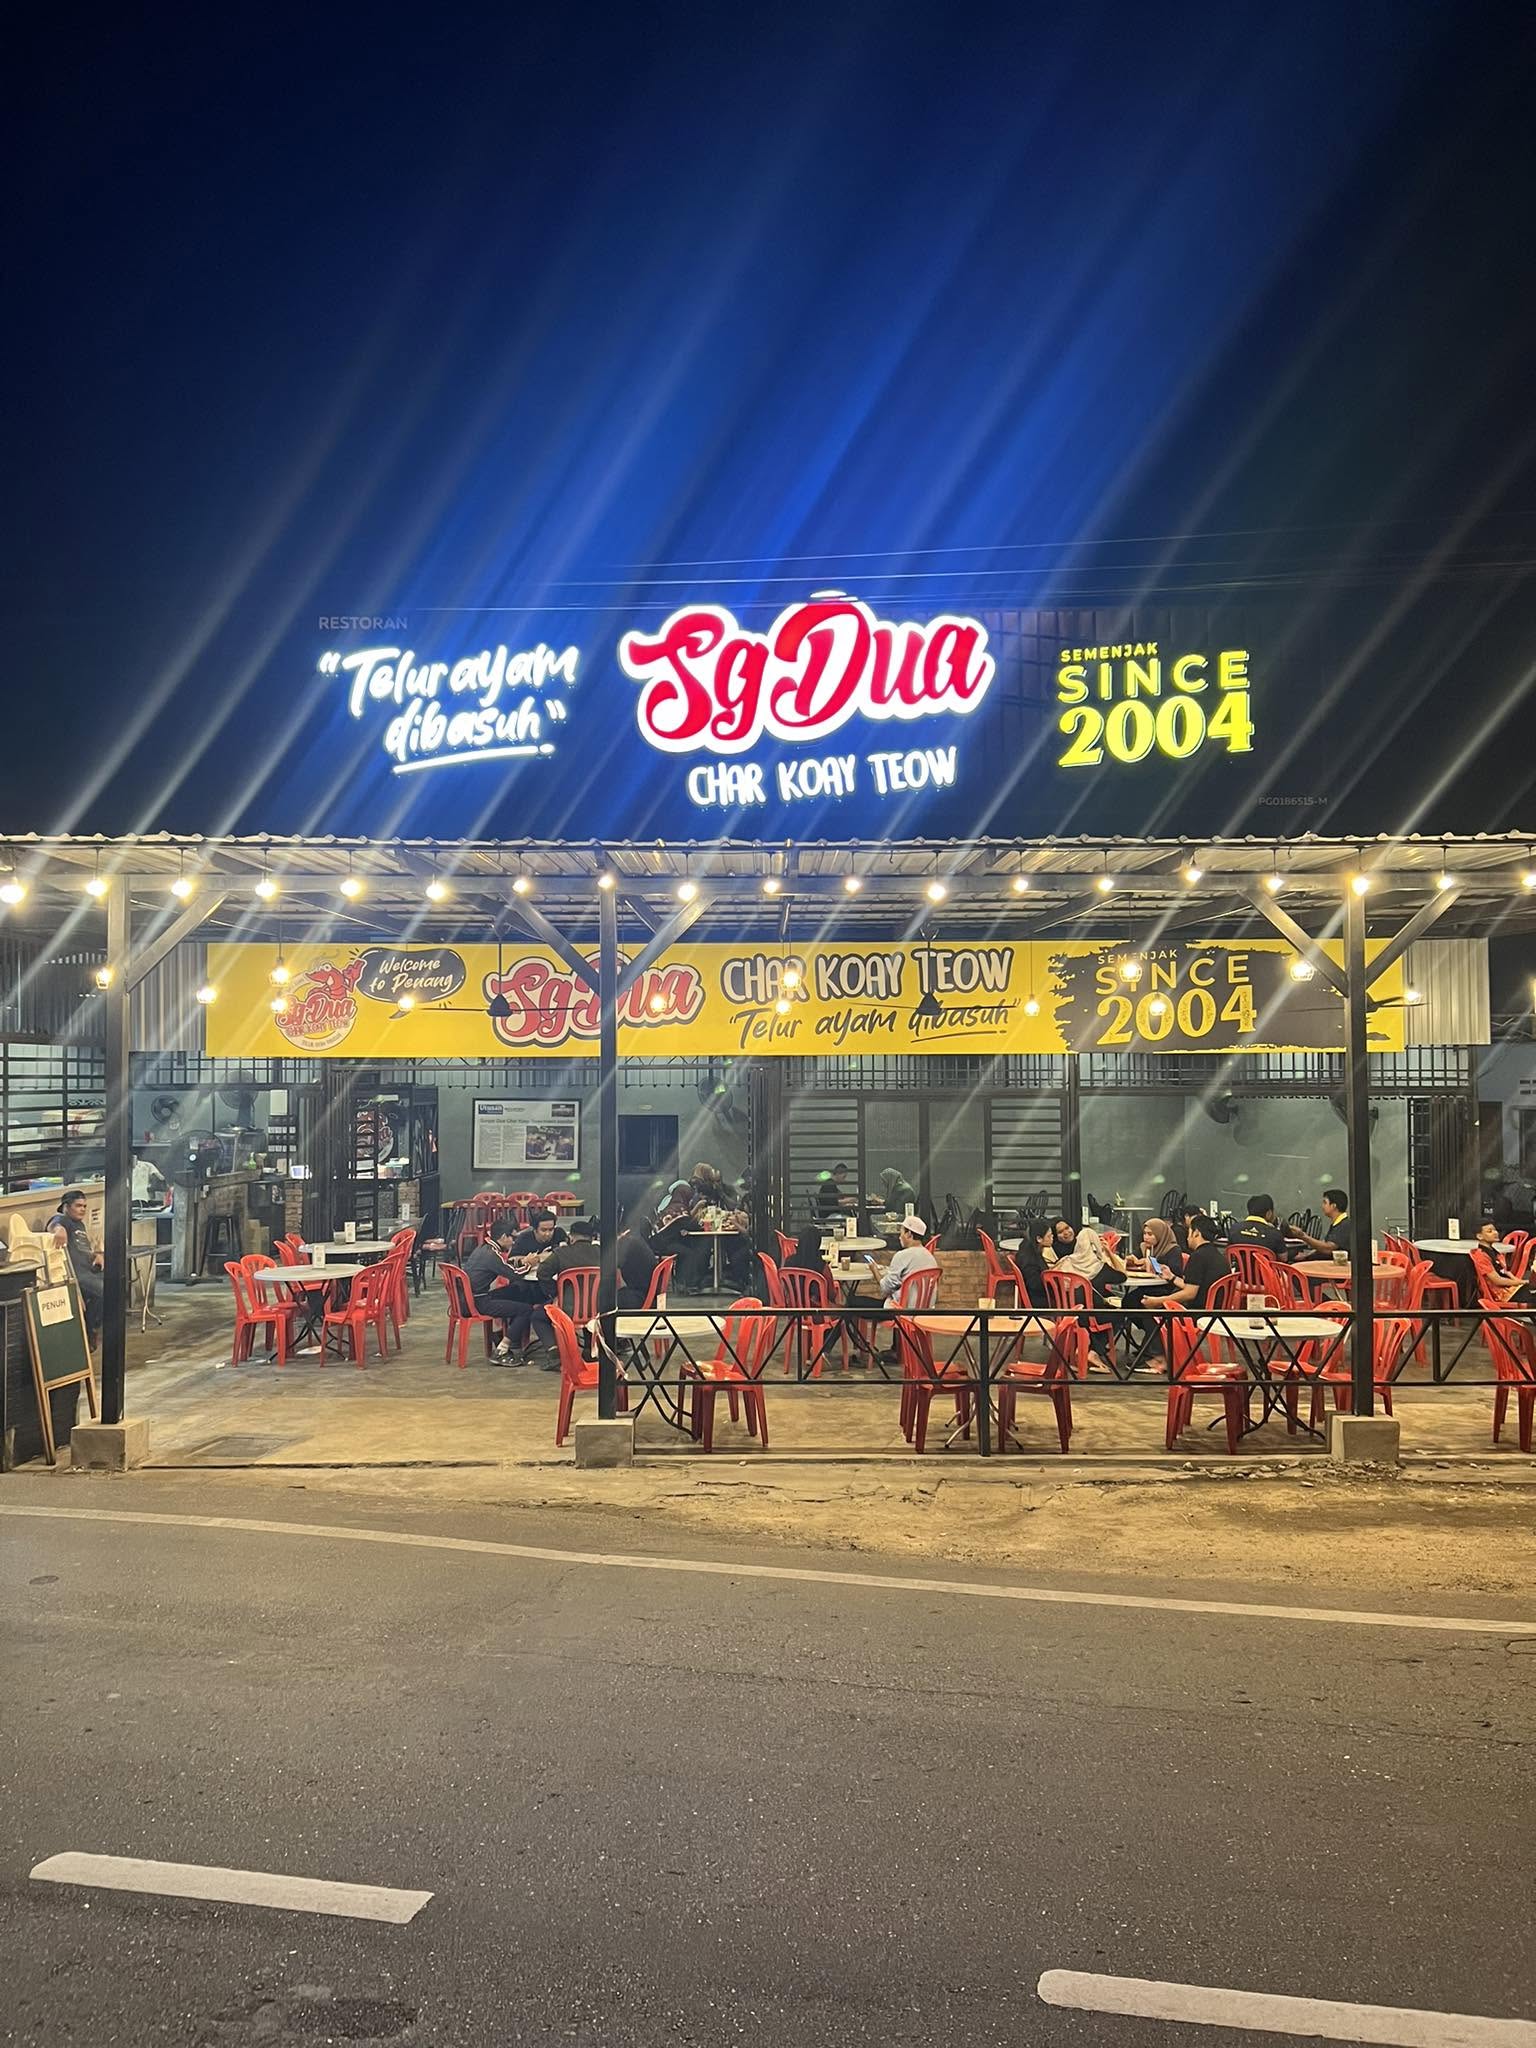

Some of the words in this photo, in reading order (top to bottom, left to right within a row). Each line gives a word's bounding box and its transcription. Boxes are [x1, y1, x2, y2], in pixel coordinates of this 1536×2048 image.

[318, 616, 408, 630] RESTORAN
[449, 643, 580, 708] ayam
[627, 611, 770, 742] Sg
[769, 598, 989, 729] Dua
[1057, 650, 1251, 704] SINCE
[1060, 641, 1158, 664] SEMENJAK
[1057, 690, 1256, 768] 2004
[687, 761, 767, 806] CHAR
[777, 754, 857, 801] KOAY
[867, 746, 958, 794] TEOW
[369, 978, 385, 993] to
[391, 970, 453, 994] Penang
[378, 957, 441, 976] Welcome
[720, 953, 810, 1005] CHAR
[815, 952, 905, 1001] KOAY
[911, 947, 1014, 995] TEOW
[815, 1009, 897, 1047] ayam
[1096, 984, 1257, 1045] 2004
[41, 1299, 66, 1311] PENUH
